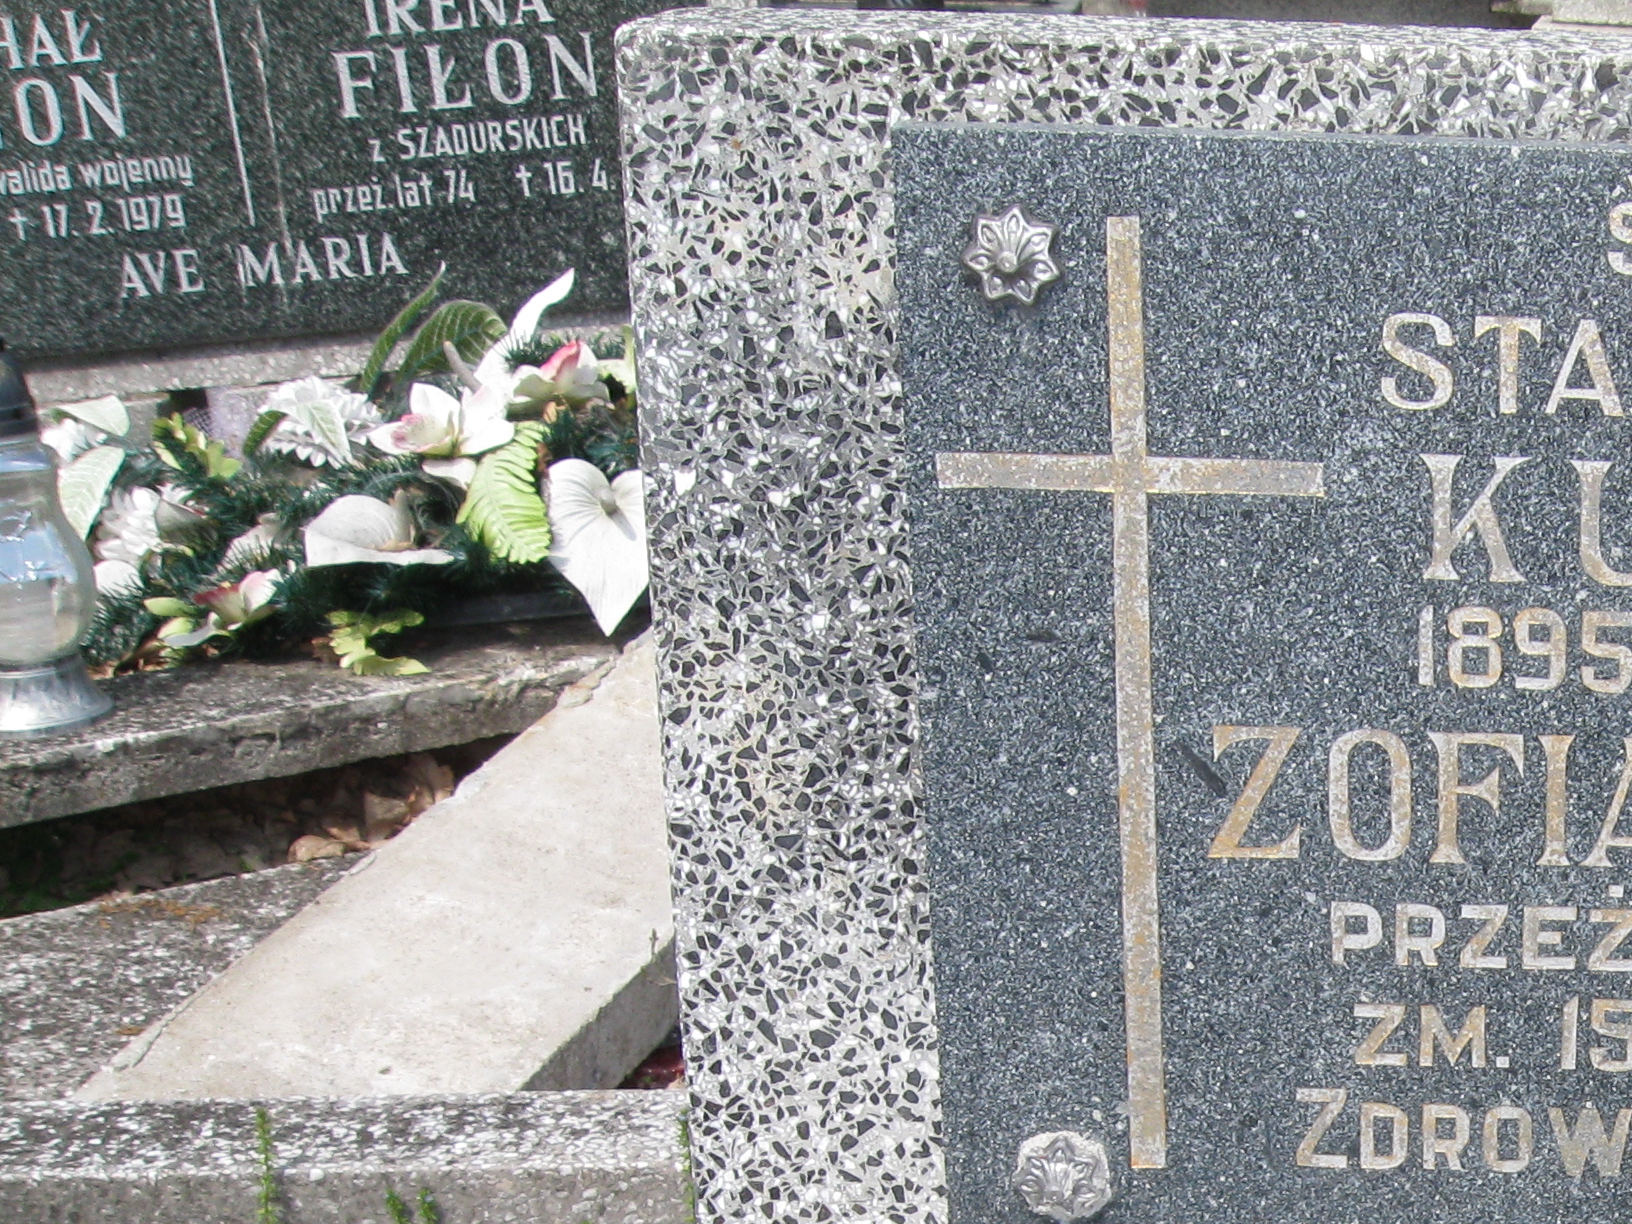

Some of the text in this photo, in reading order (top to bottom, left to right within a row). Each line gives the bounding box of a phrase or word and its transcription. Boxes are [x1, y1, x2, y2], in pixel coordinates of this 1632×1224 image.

[331, 31, 599, 119] FIŁON
[0, 71, 127, 147] ON
[397, 113, 587, 161] SZADURSKICH
[77, 152, 195, 194] wojenny
[444, 168, 476, 204] 74
[120, 231, 409, 298] AVE MARIA
[1352, 1002, 1511, 1069] ZM.
